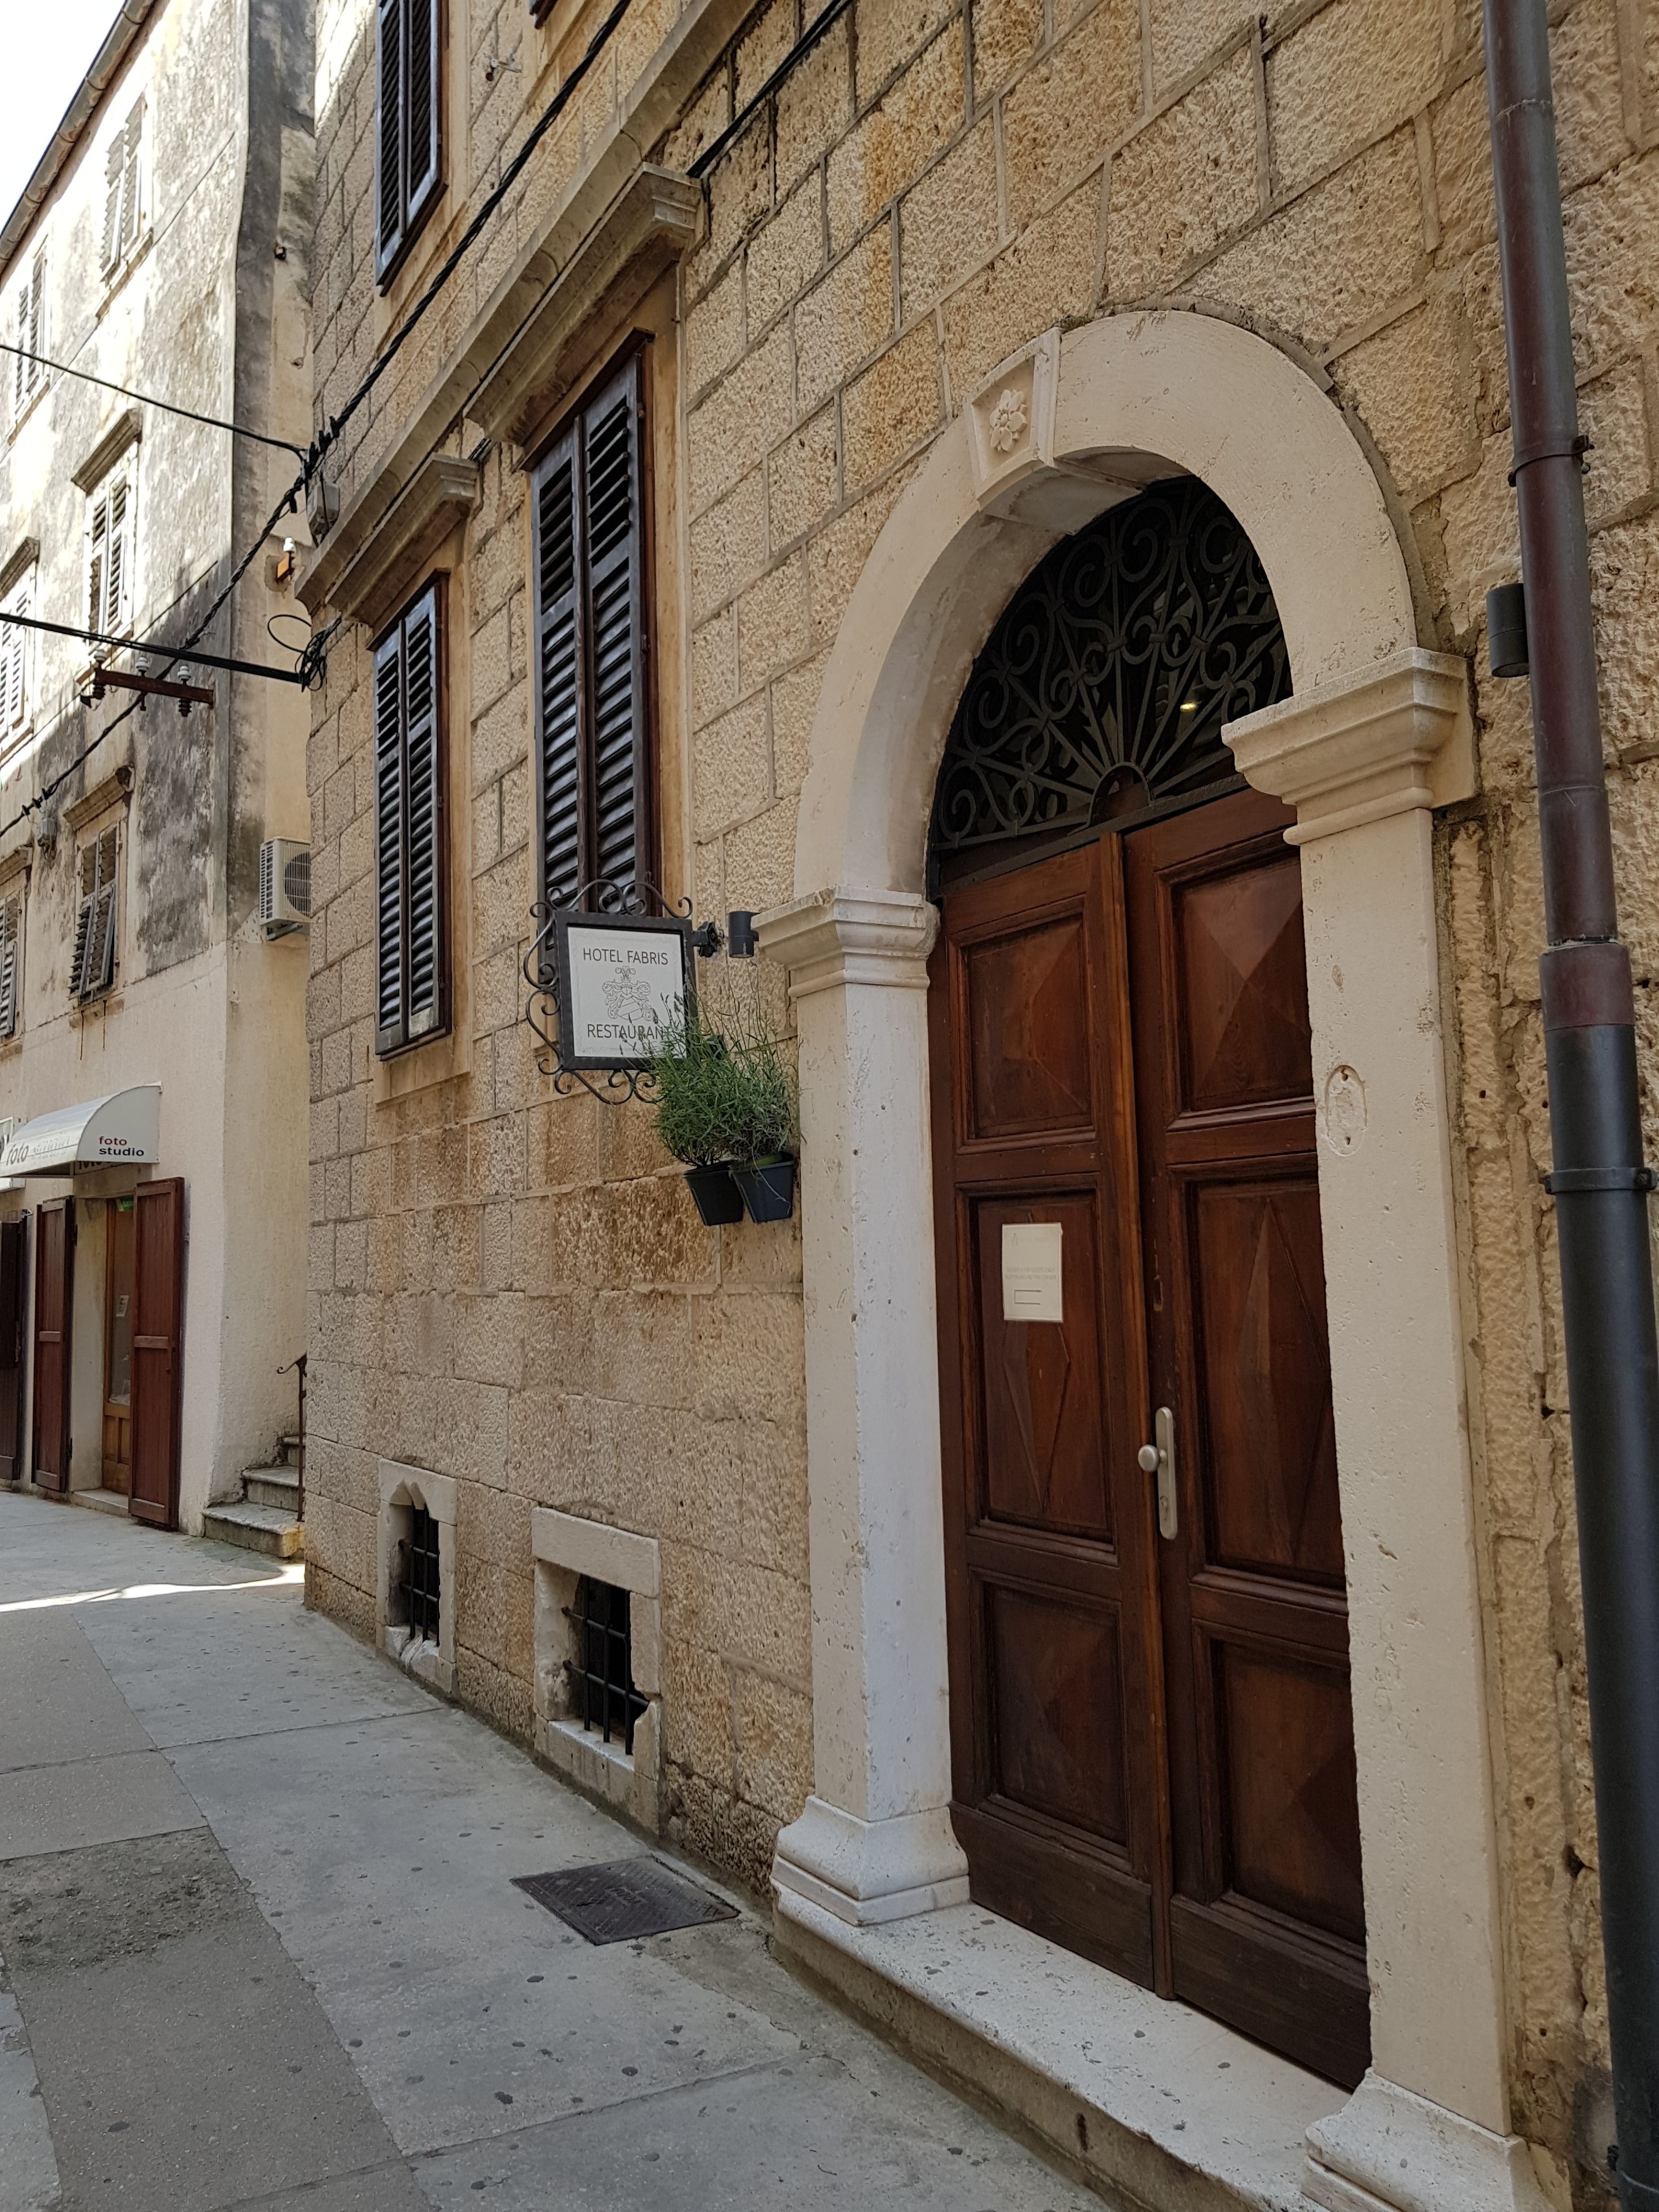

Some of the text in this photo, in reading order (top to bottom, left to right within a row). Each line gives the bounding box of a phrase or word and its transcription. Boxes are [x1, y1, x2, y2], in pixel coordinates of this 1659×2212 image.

[583, 948, 668, 965] HOTEL FABRIS
[99, 1136, 127, 1146] foto
[99, 1147, 144, 1157] studio
